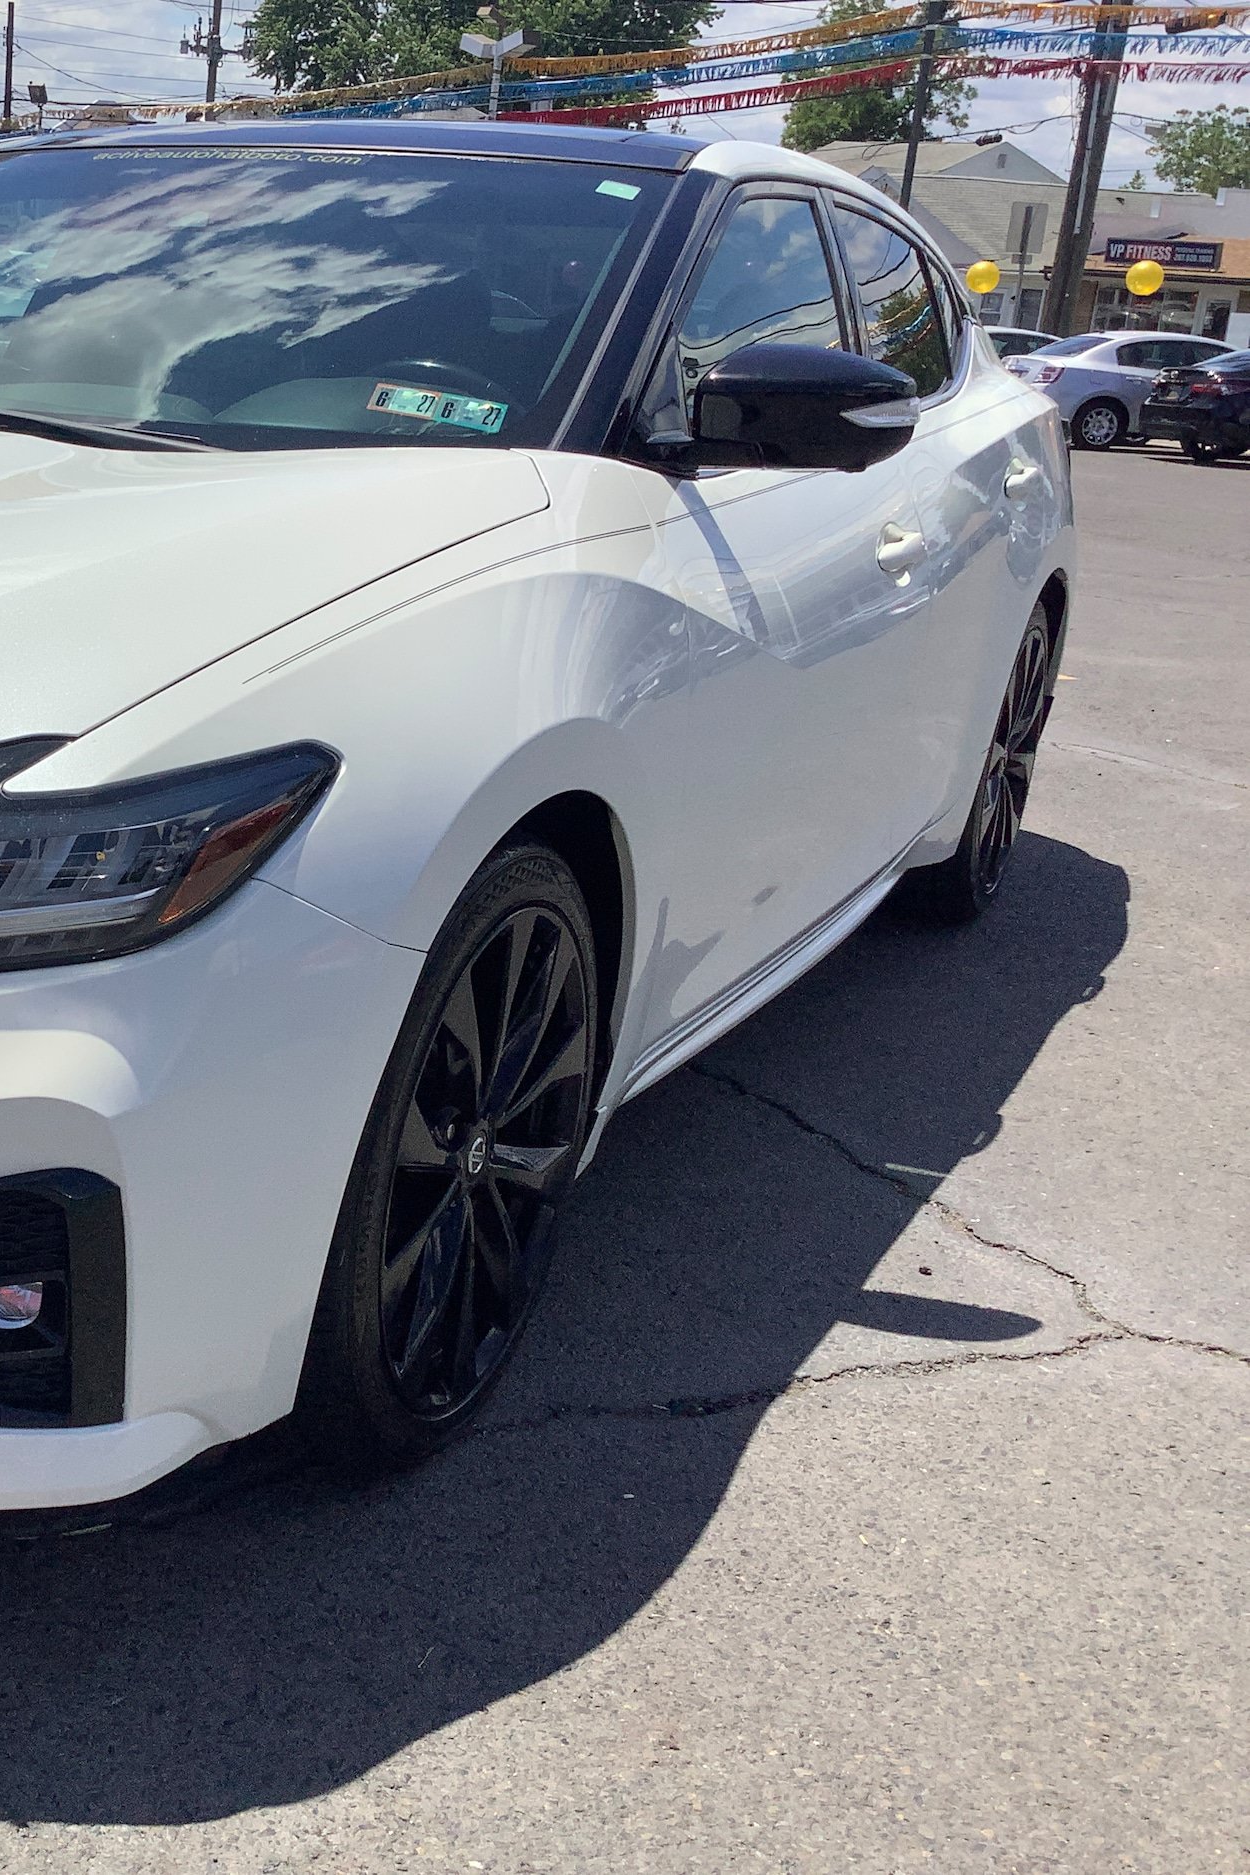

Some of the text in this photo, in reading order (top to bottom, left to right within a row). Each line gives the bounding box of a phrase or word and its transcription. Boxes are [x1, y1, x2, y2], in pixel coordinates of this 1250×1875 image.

[1110, 243, 1125, 259] VP
[1126, 244, 1172, 261] FITNESS
[375, 391, 501, 426] 6 27 6 27
